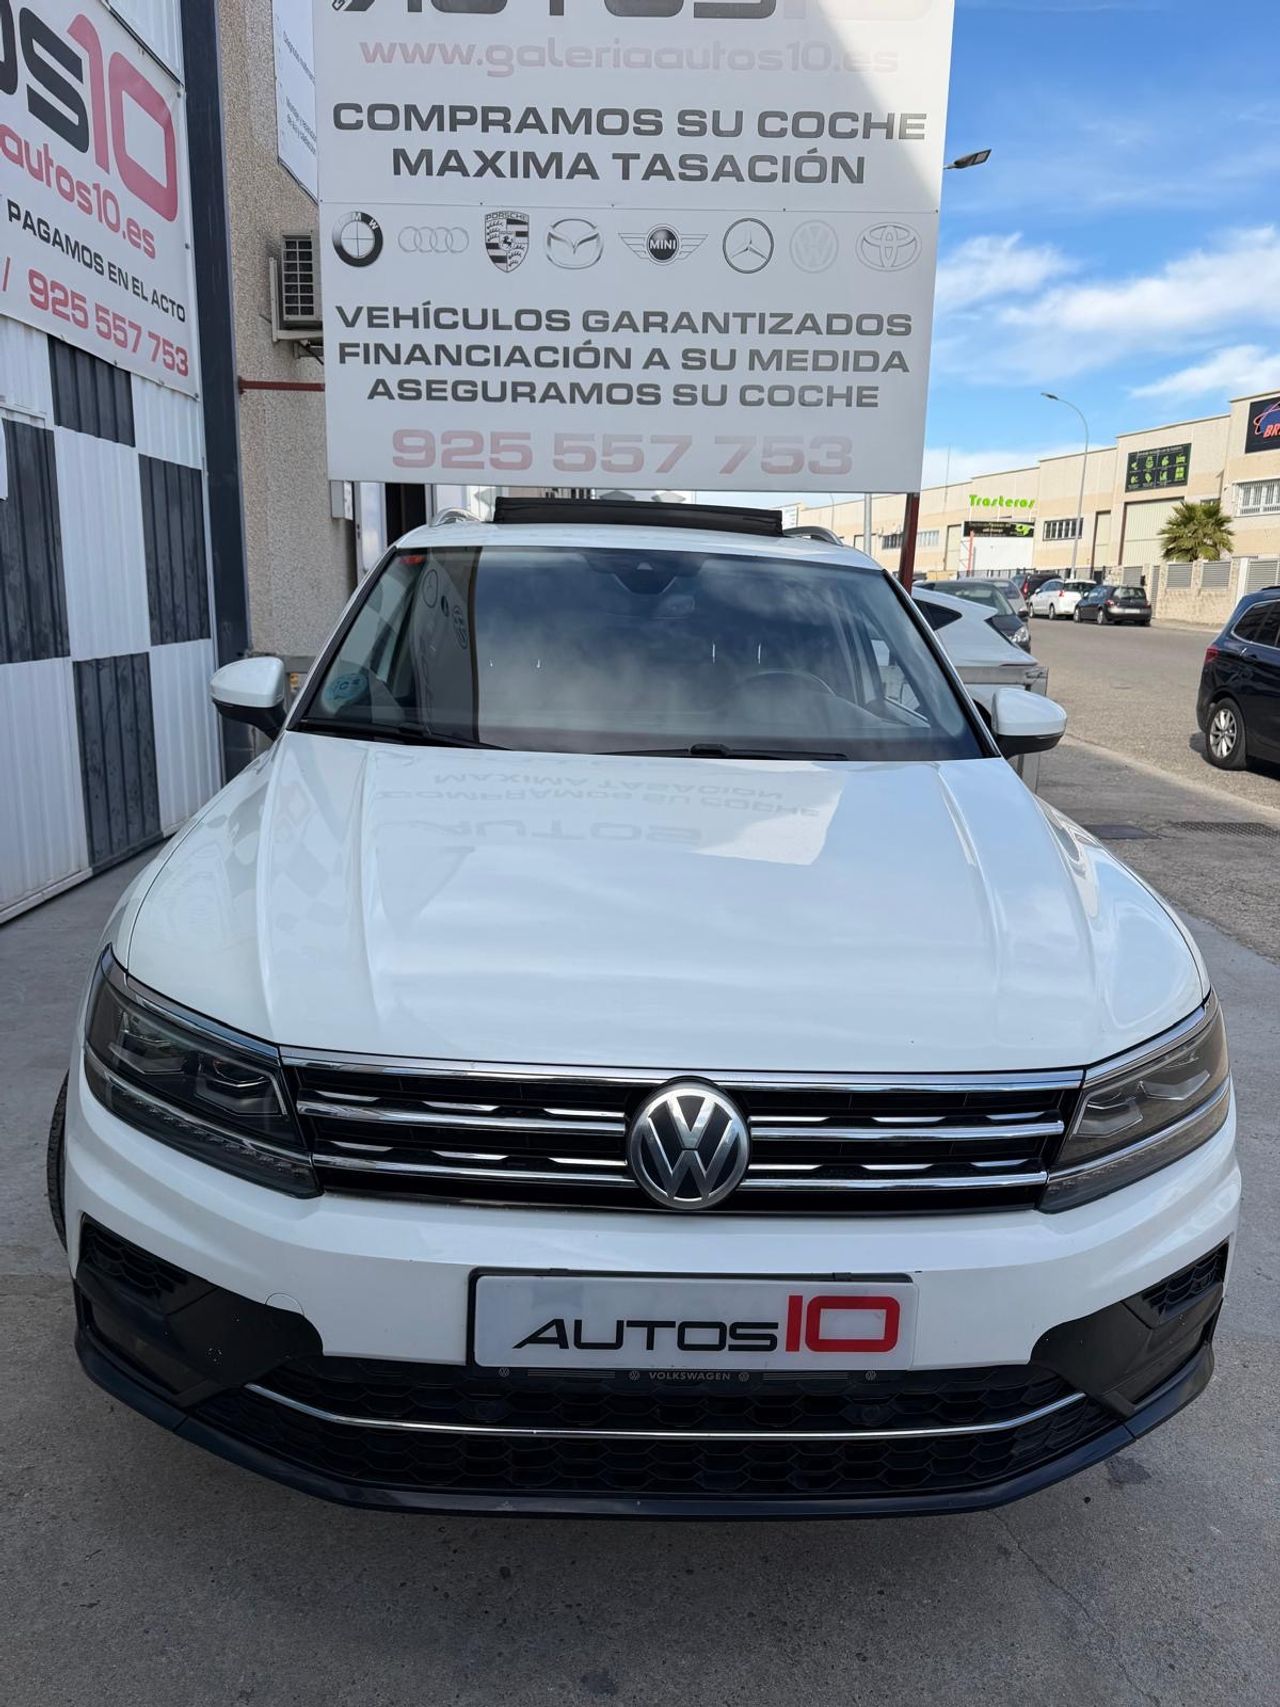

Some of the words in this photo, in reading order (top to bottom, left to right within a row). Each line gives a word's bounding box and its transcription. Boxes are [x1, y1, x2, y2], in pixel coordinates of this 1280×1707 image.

[359, 36, 900, 78] www.galeriaautos10.es
[332, 102, 664, 137] COMPRAMOS
[676, 107, 743, 138] SU
[757, 110, 927, 141] COCHE
[392, 148, 600, 181] MAXIMA
[611, 147, 866, 186] TASACIÓN
[7, 198, 105, 276] PAGAMOS
[108, 262, 129, 291] EN
[132, 276, 148, 301] EL
[151, 289, 186, 323] ACTO
[650, 239, 677, 250] MINI
[28, 268, 89, 330] 925
[95, 302, 142, 353] 557
[147, 331, 189, 377] 753
[335, 300, 571, 332] VEHÍCULOS
[582, 310, 913, 336] GARANTIZADOS
[338, 340, 632, 370] FINANCIACIÓN
[641, 348, 672, 371] A
[681, 348, 738, 372] SU
[748, 349, 910, 374] MEDIDA
[367, 378, 662, 406] ASEGURAMOS
[672, 381, 728, 407] SU
[739, 384, 880, 408] COCHE
[392, 428, 533, 472] 925
[553, 432, 694, 475] 557
[713, 435, 854, 475] 753
[969, 494, 1035, 509] Trasteros
[648, 1372, 731, 1382] VOLKSWAGEN
